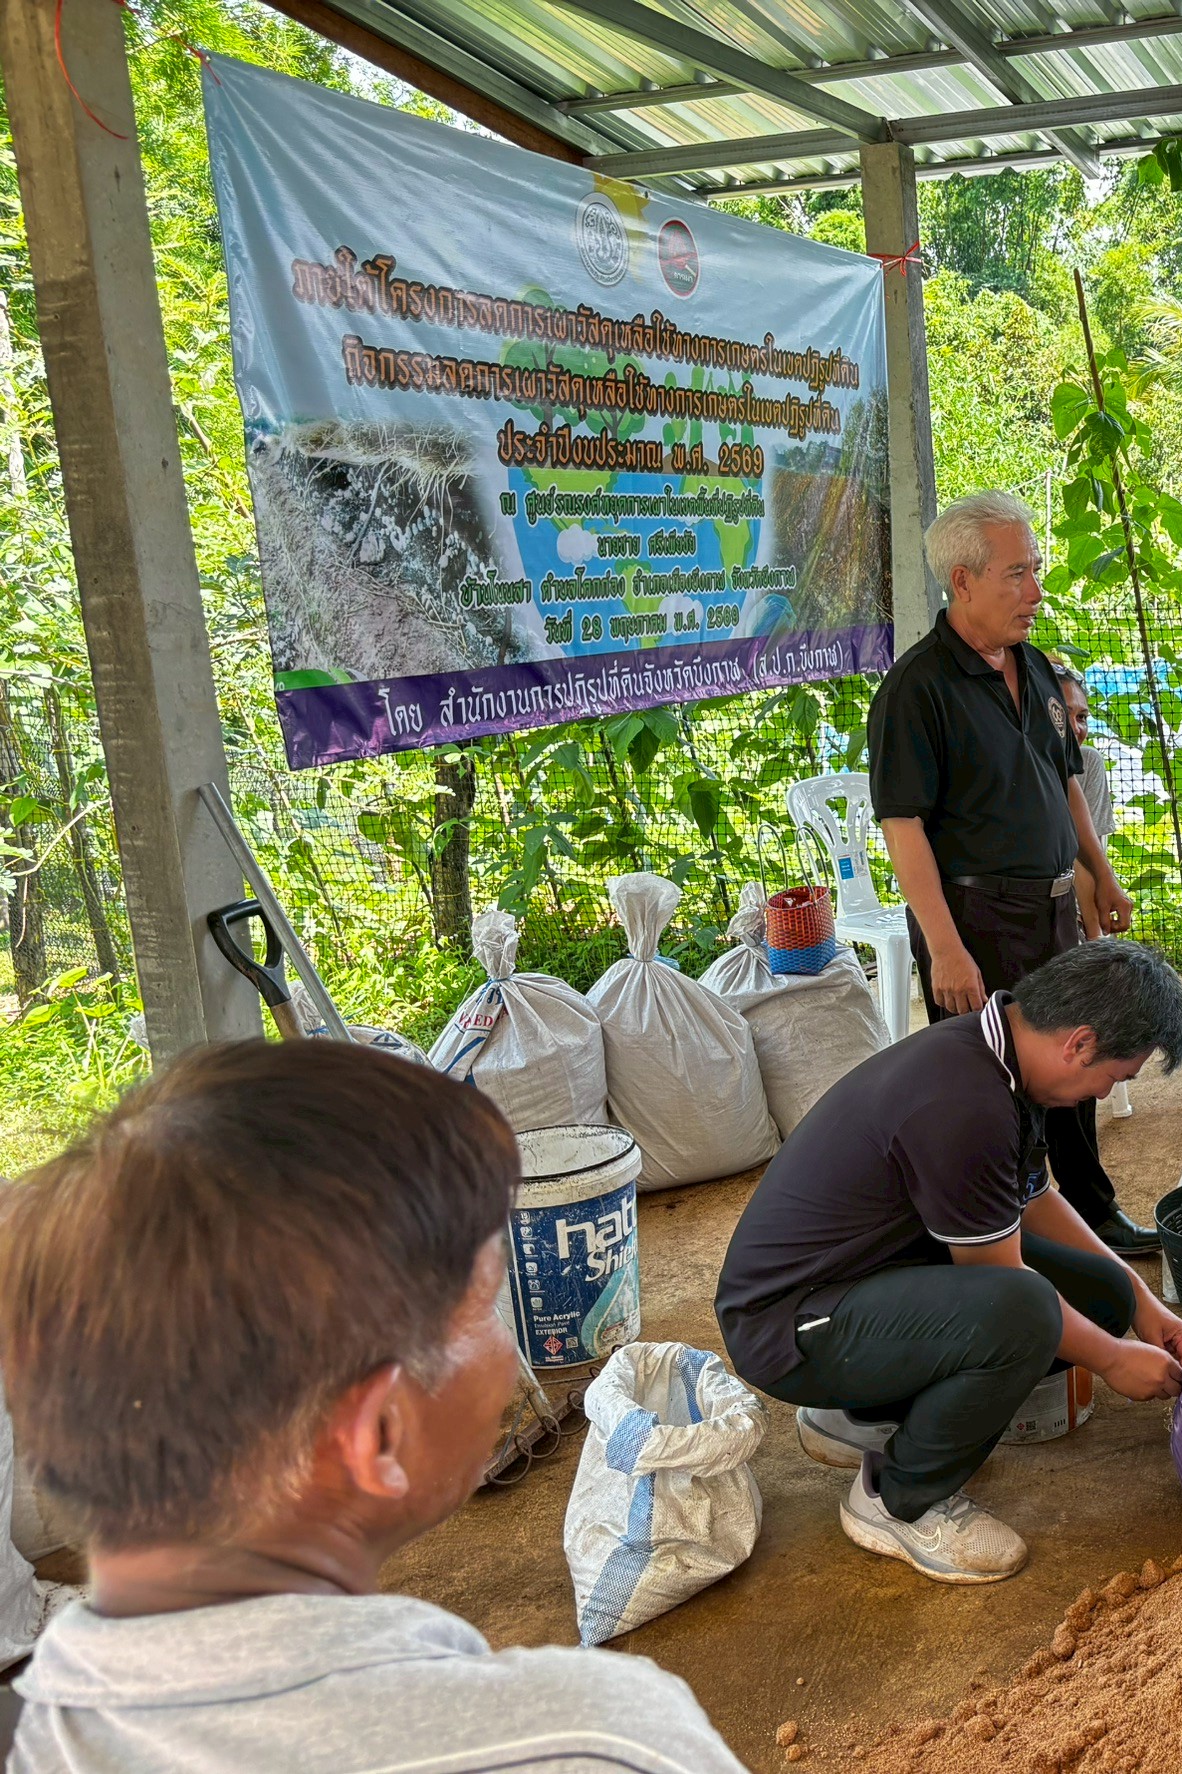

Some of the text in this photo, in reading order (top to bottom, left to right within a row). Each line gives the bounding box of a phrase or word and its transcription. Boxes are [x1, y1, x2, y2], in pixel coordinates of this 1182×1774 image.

[292, 246, 860, 390] ภายใต้โครงการลดการเผาวัสดุเหลือใช้ทางการเกษตรในเขตปฏิรูปที่ดิน
[343, 335, 841, 441] กิจกรรมลดการเผาวัสดุเหลือใช้ทางการเกษตรในเขตปฏิรูปที่ดิน
[498, 419, 764, 477] ประจำปีงบประมาณ พ.ศ. 2569
[500, 491, 516, 516] ณ
[545, 604, 740, 645] วันที่ 28 พฤษภาคม พ.ศ. 2569
[378, 641, 843, 736] โดย สำนักงานการปฏิรูปที่ดินจังหวัดบึงกาฬ (ส.ป.ก.บึงกาฬ)
[556, 1196, 636, 1259] nat
[535, 1327, 568, 1336] EXTERIOR
[553, 1311, 581, 1321] Acrylic
